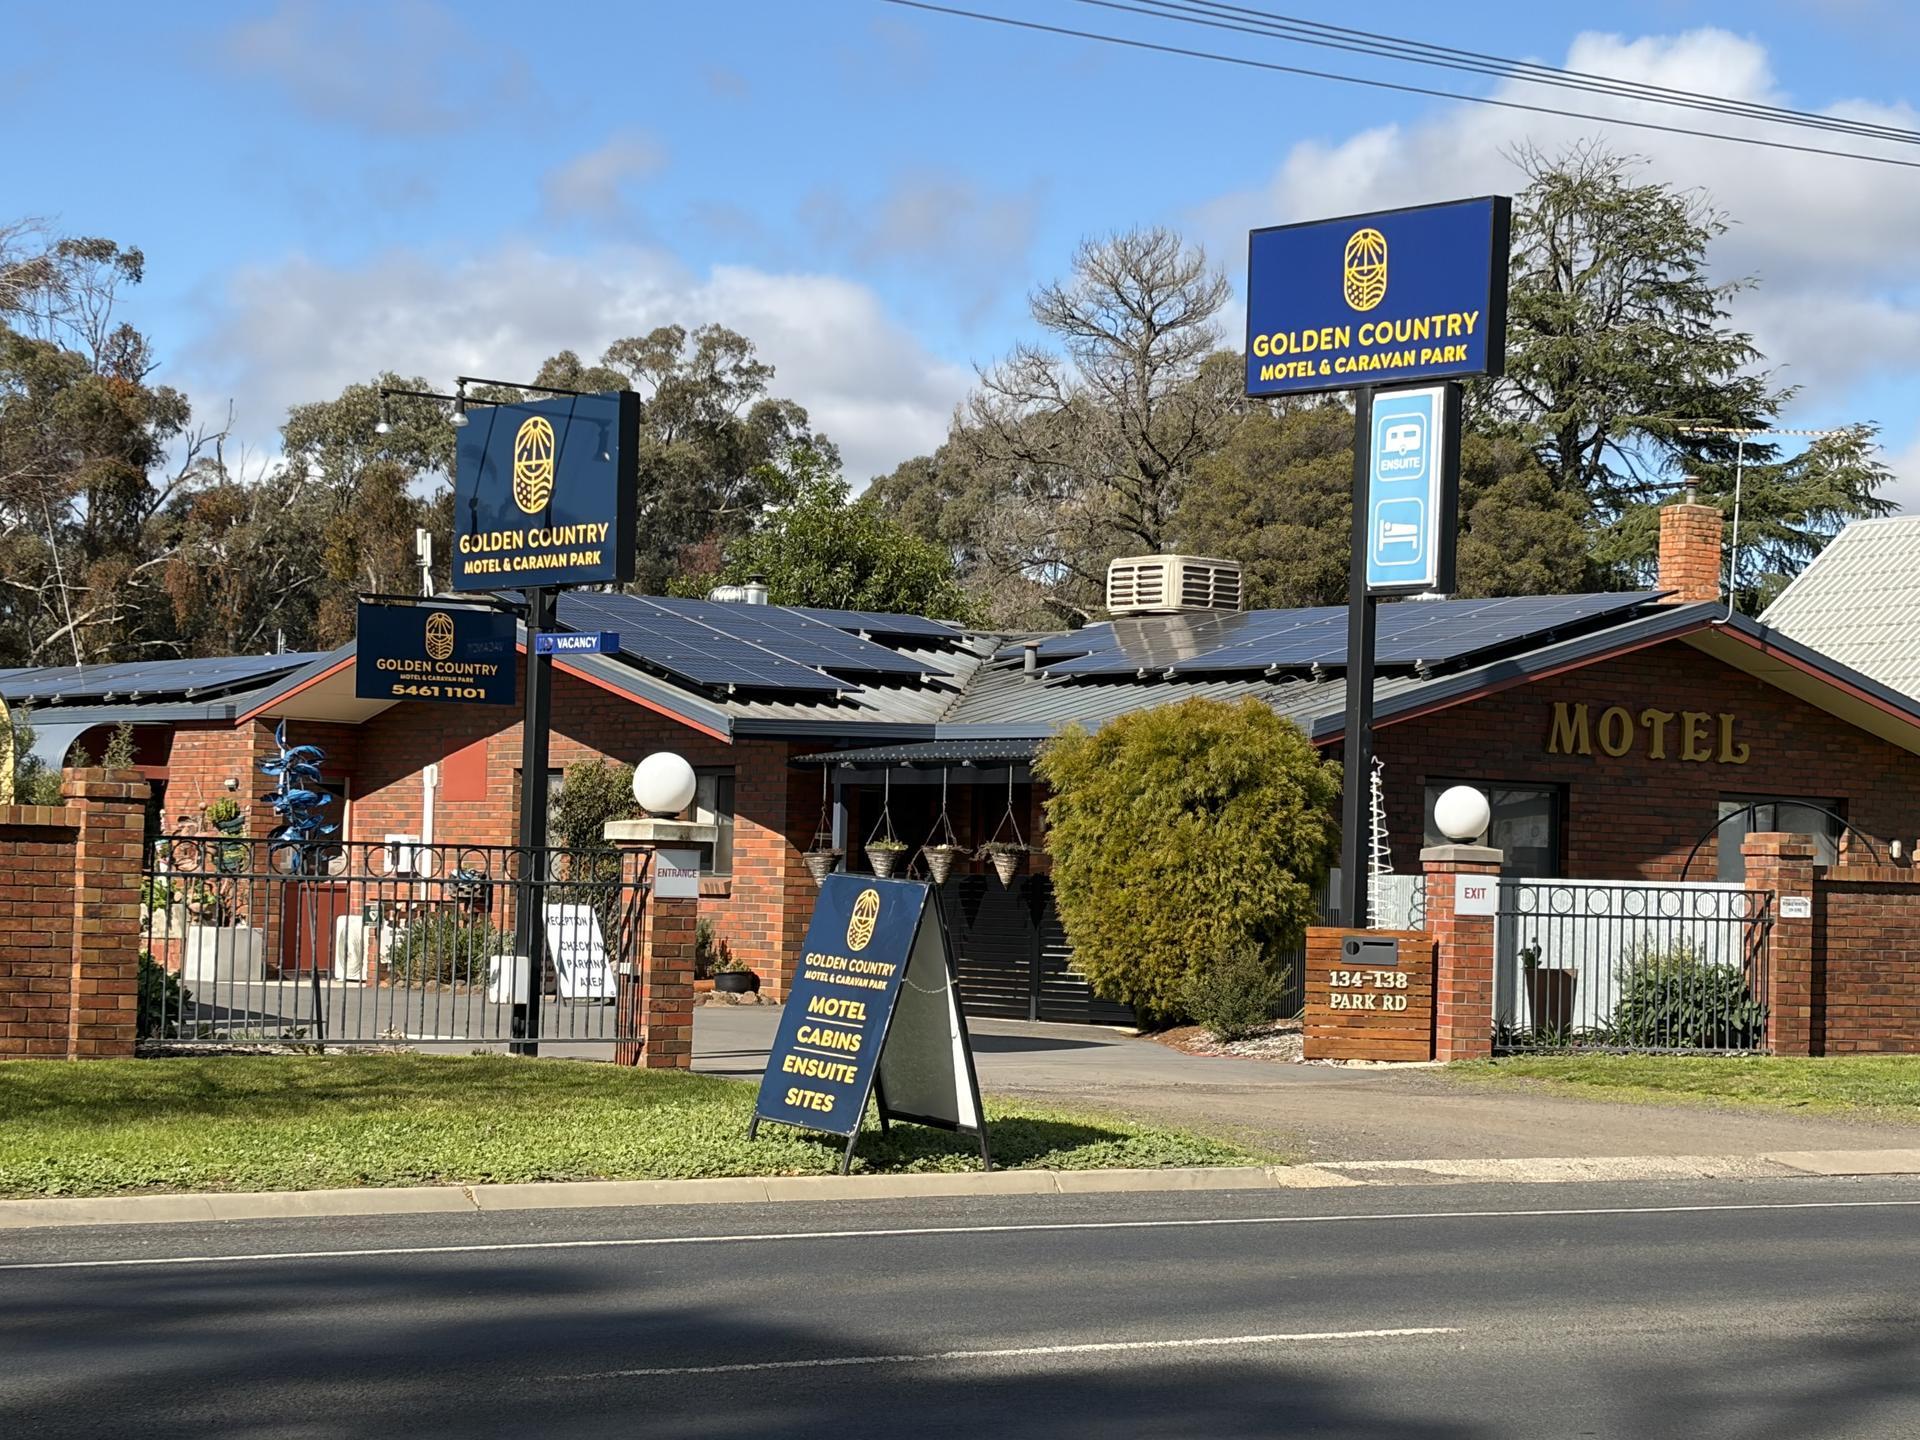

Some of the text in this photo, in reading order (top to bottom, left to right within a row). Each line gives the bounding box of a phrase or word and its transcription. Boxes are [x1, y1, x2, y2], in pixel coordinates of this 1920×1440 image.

[1253, 310, 1479, 357] GOLDEN COUNTRY
[1260, 344, 1468, 381] MOTEL & CARAVAN PARK
[1381, 456, 1421, 472] ENSUITE
[459, 522, 609, 554] GOLDEN COUNTRY
[464, 550, 602, 575] MOTEL & CARAVAN PARK
[557, 636, 597, 649] VACANCY
[376, 658, 498, 676] GOLDEN COUNTRY
[427, 674, 457, 682] CARAVAN
[391, 684, 486, 699] 5461 1101
[1548, 702, 1750, 764] MOTEL
[657, 868, 697, 878] ENTRANCE
[1464, 887, 1487, 899] EXIT
[805, 952, 896, 977] GOLDEN COUNTRY
[804, 970, 888, 990] MOTEL & CARAVAN PARK
[1329, 970, 1408, 989] 134-138
[808, 995, 867, 1021] MOTEL
[1329, 993, 1408, 1011] PARK RD
[797, 1025, 863, 1052] CABINS
[782, 1054, 858, 1084] ENSUITE
[784, 1087, 835, 1112] SITES
